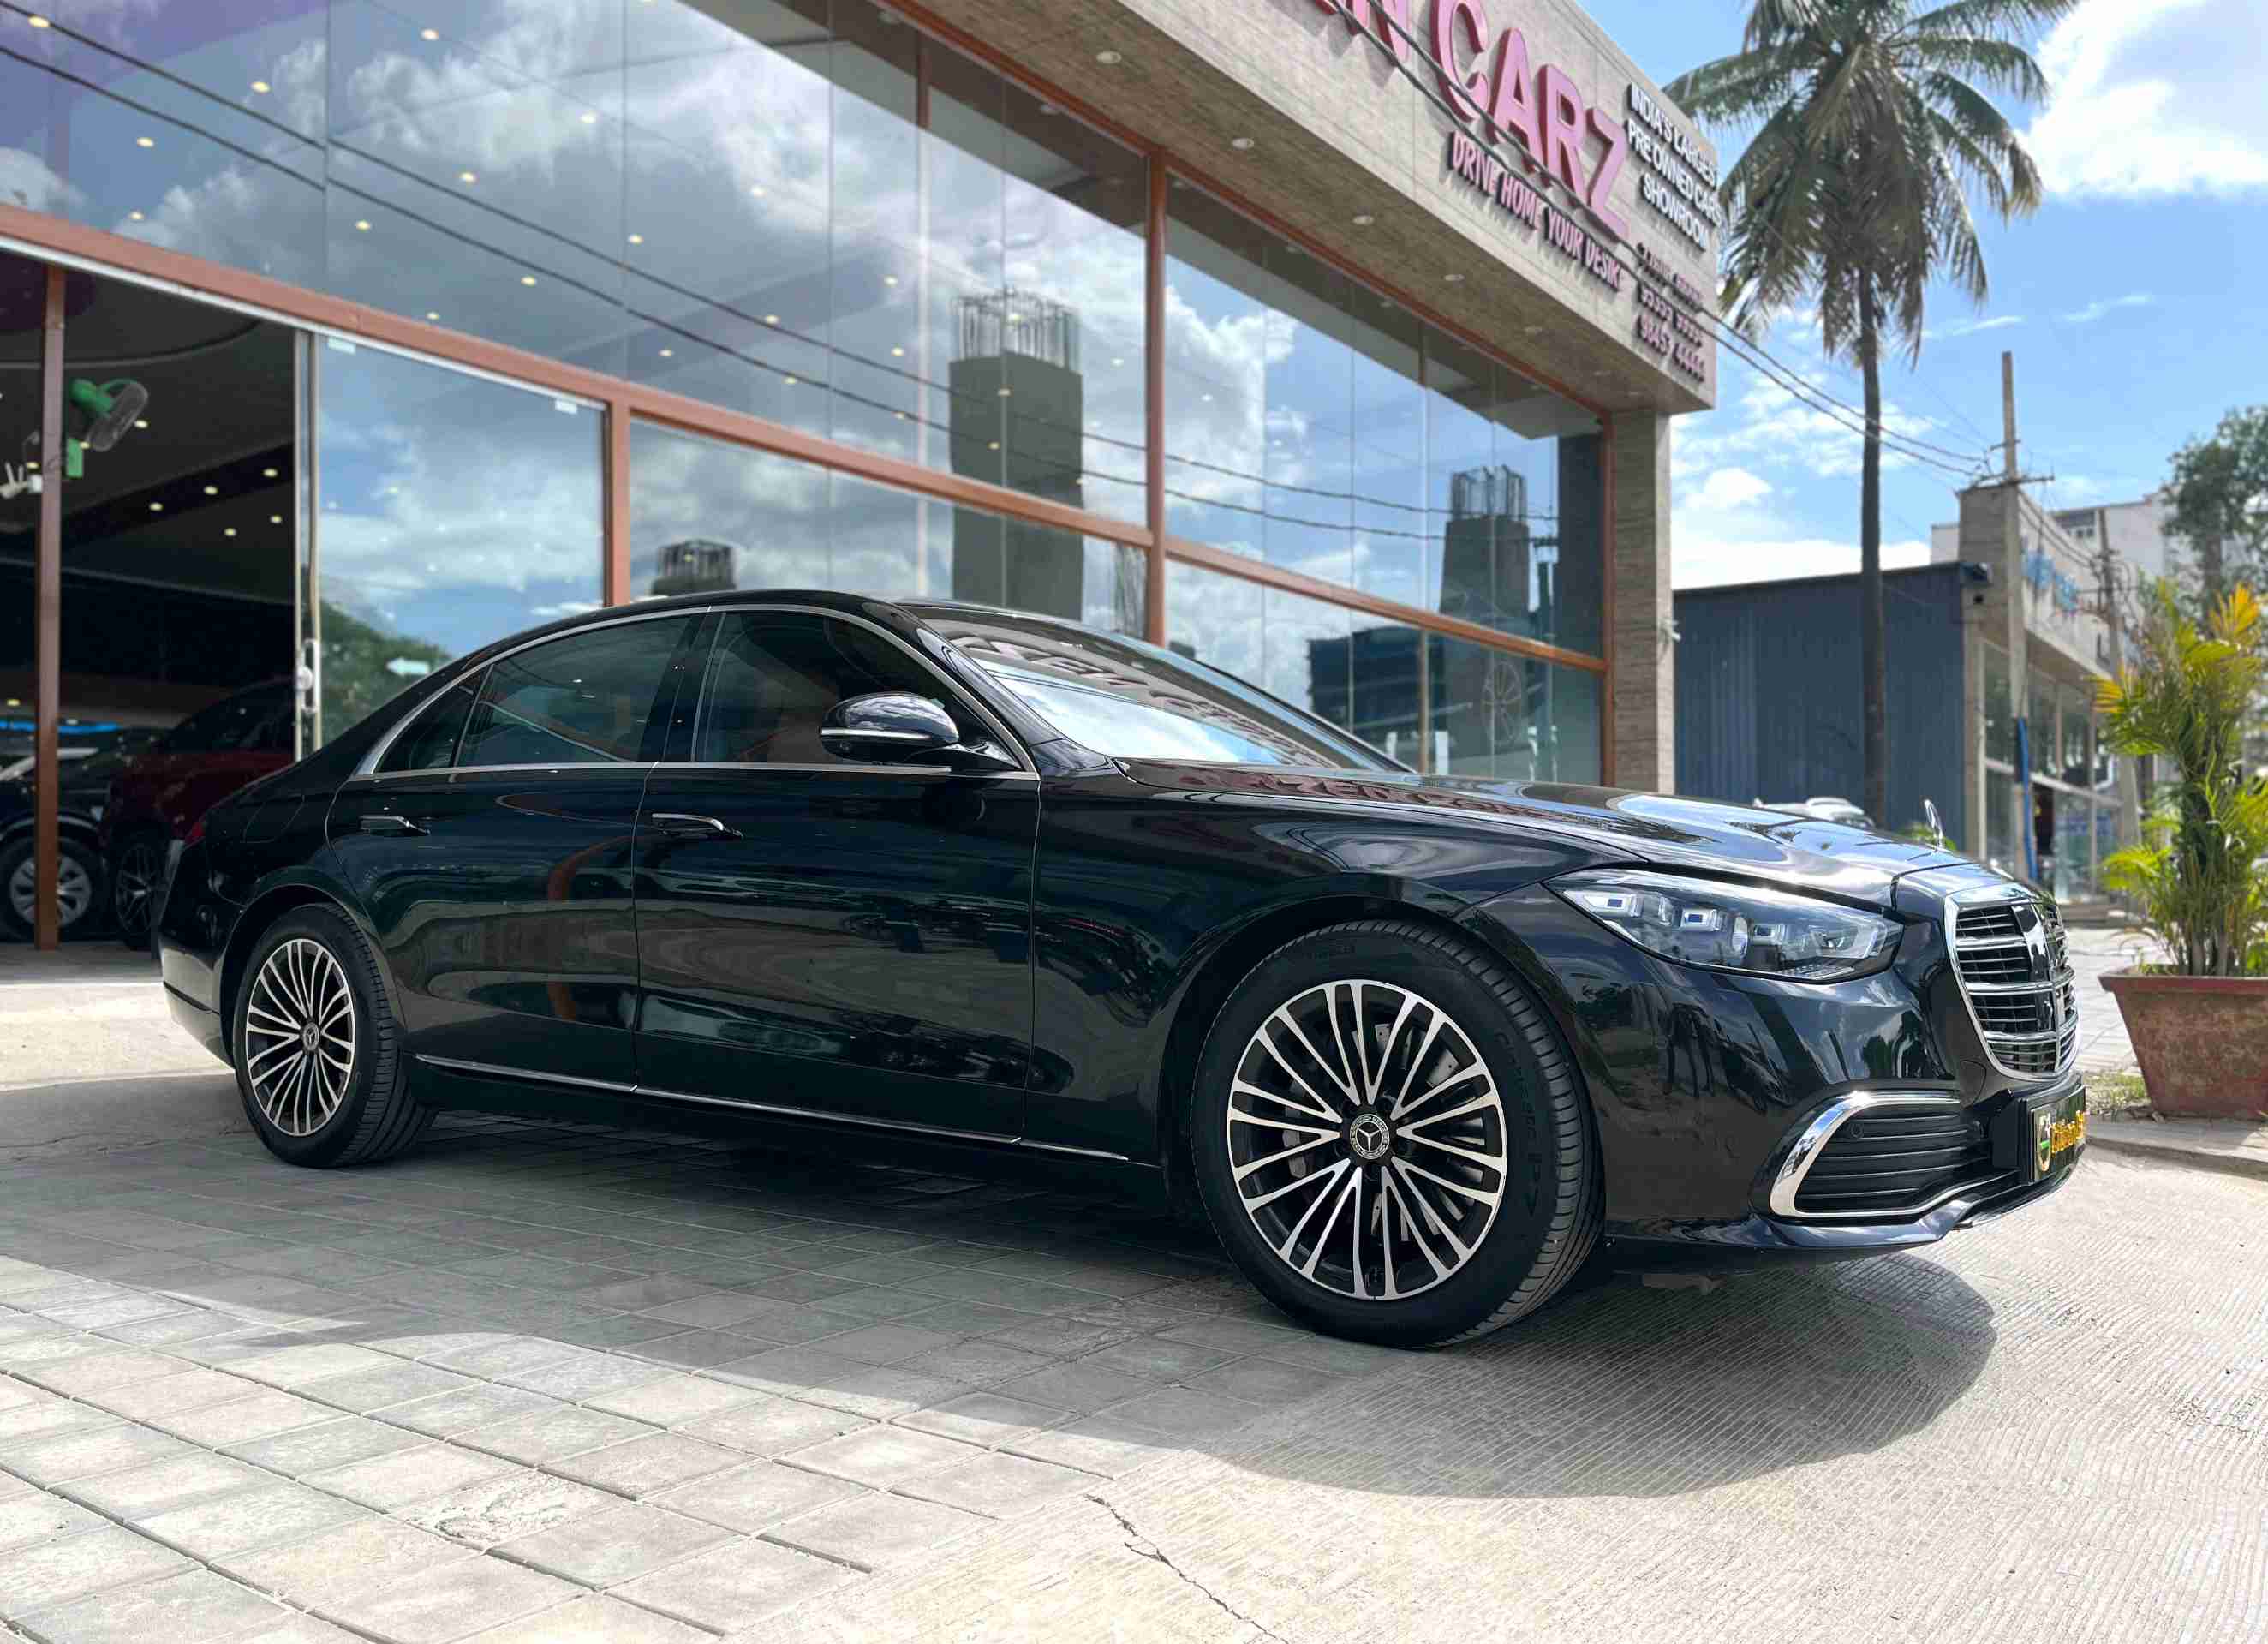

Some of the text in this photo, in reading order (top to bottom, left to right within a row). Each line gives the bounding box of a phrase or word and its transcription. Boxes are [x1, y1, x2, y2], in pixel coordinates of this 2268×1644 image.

[1432, 0, 1628, 242] CARZ
[1625, 118, 1722, 228] PRE OWNED CARS
[1673, 126, 1716, 188] LARGES
[1447, 129, 1496, 195] DRIVE
[1497, 170, 1542, 231] HOME
[1544, 205, 1584, 260] YOUR
[1582, 233, 1625, 291] DESIR
[1641, 172, 1710, 252] SHOWROOM
